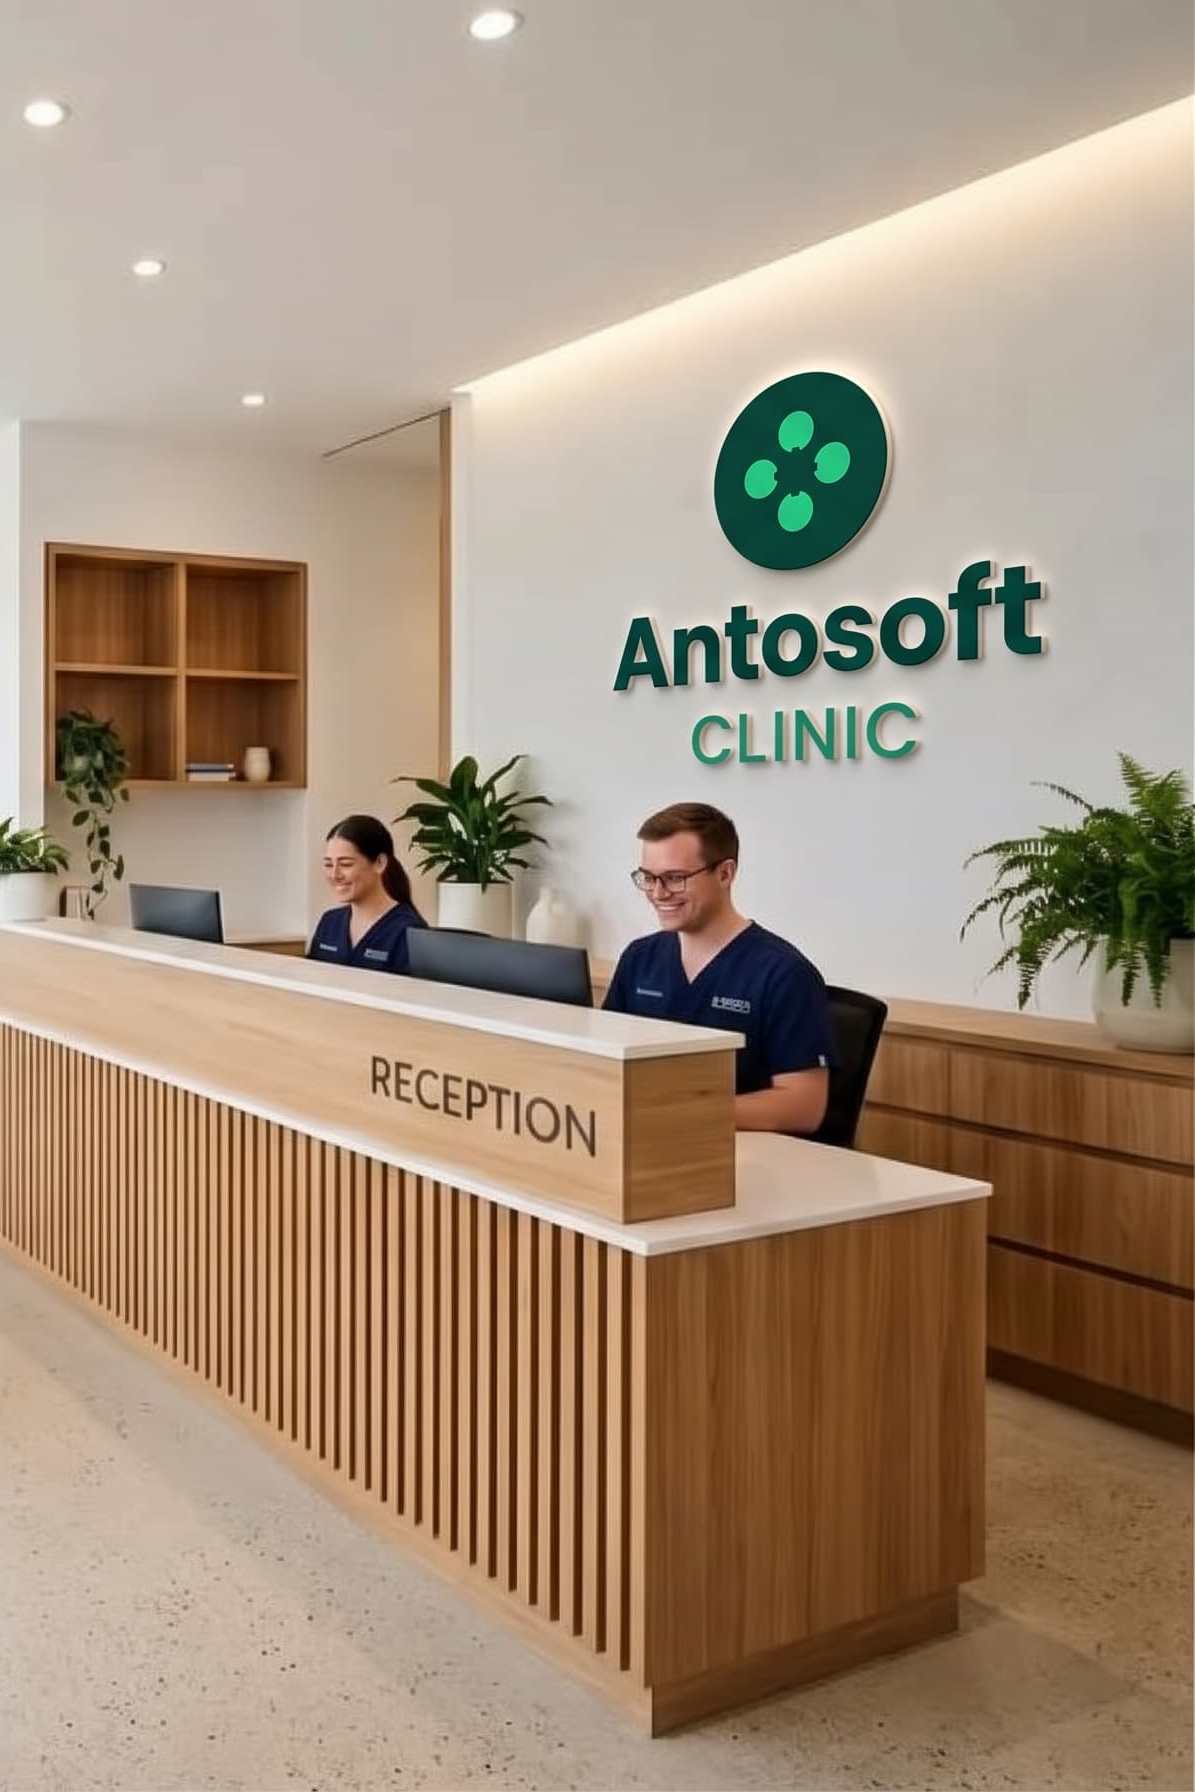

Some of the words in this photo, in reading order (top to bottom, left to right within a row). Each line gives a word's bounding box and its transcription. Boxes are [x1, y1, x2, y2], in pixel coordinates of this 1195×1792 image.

[613, 560, 1043, 691] Antosoft
[691, 702, 917, 765] CLINIC
[371, 1056, 596, 1158] RECEPTION
